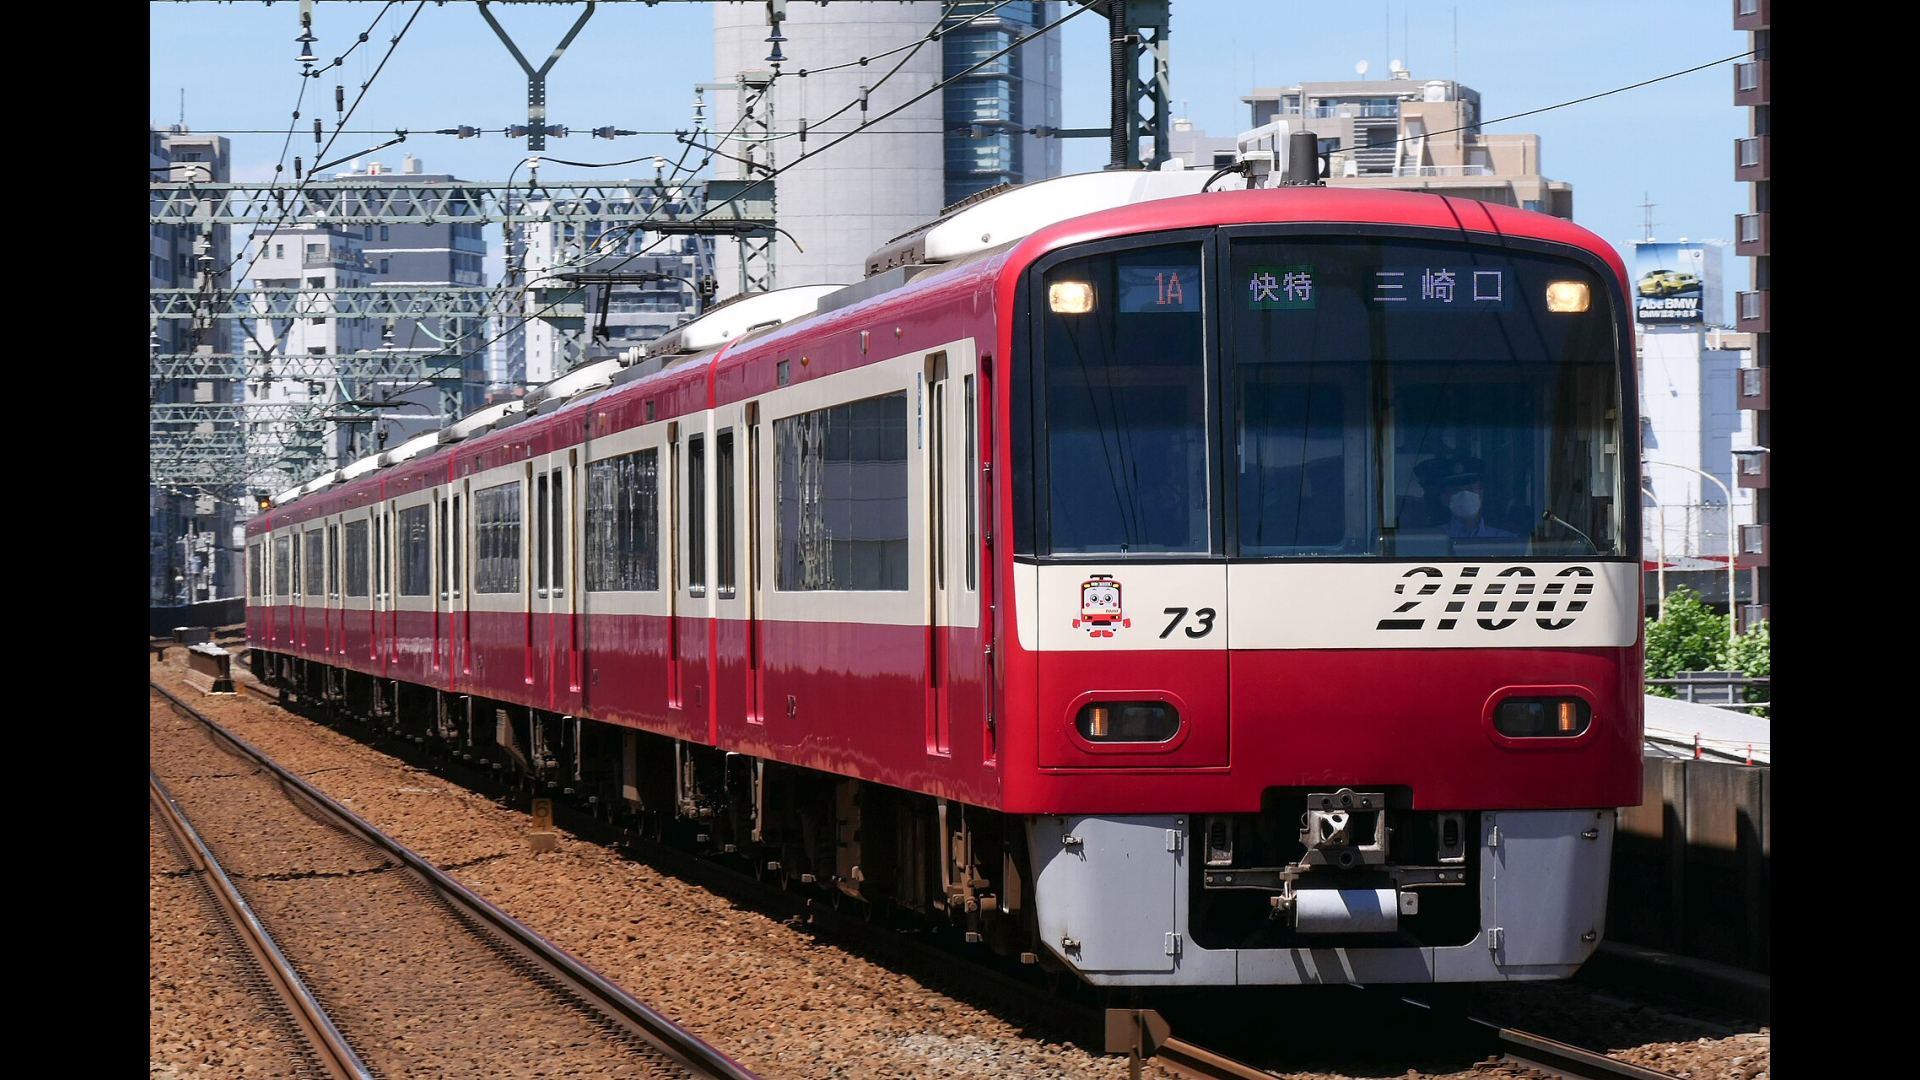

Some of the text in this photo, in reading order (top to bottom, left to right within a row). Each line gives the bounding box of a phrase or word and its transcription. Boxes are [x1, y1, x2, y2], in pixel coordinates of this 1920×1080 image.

[1154, 272, 1183, 305] 1A
[1249, 271, 1313, 302] 快特
[1373, 268, 1502, 302] 三崎口
[1640, 297, 1698, 310] Abe BMW
[1376, 566, 1594, 631] 2100
[1159, 607, 1217, 639] 73
